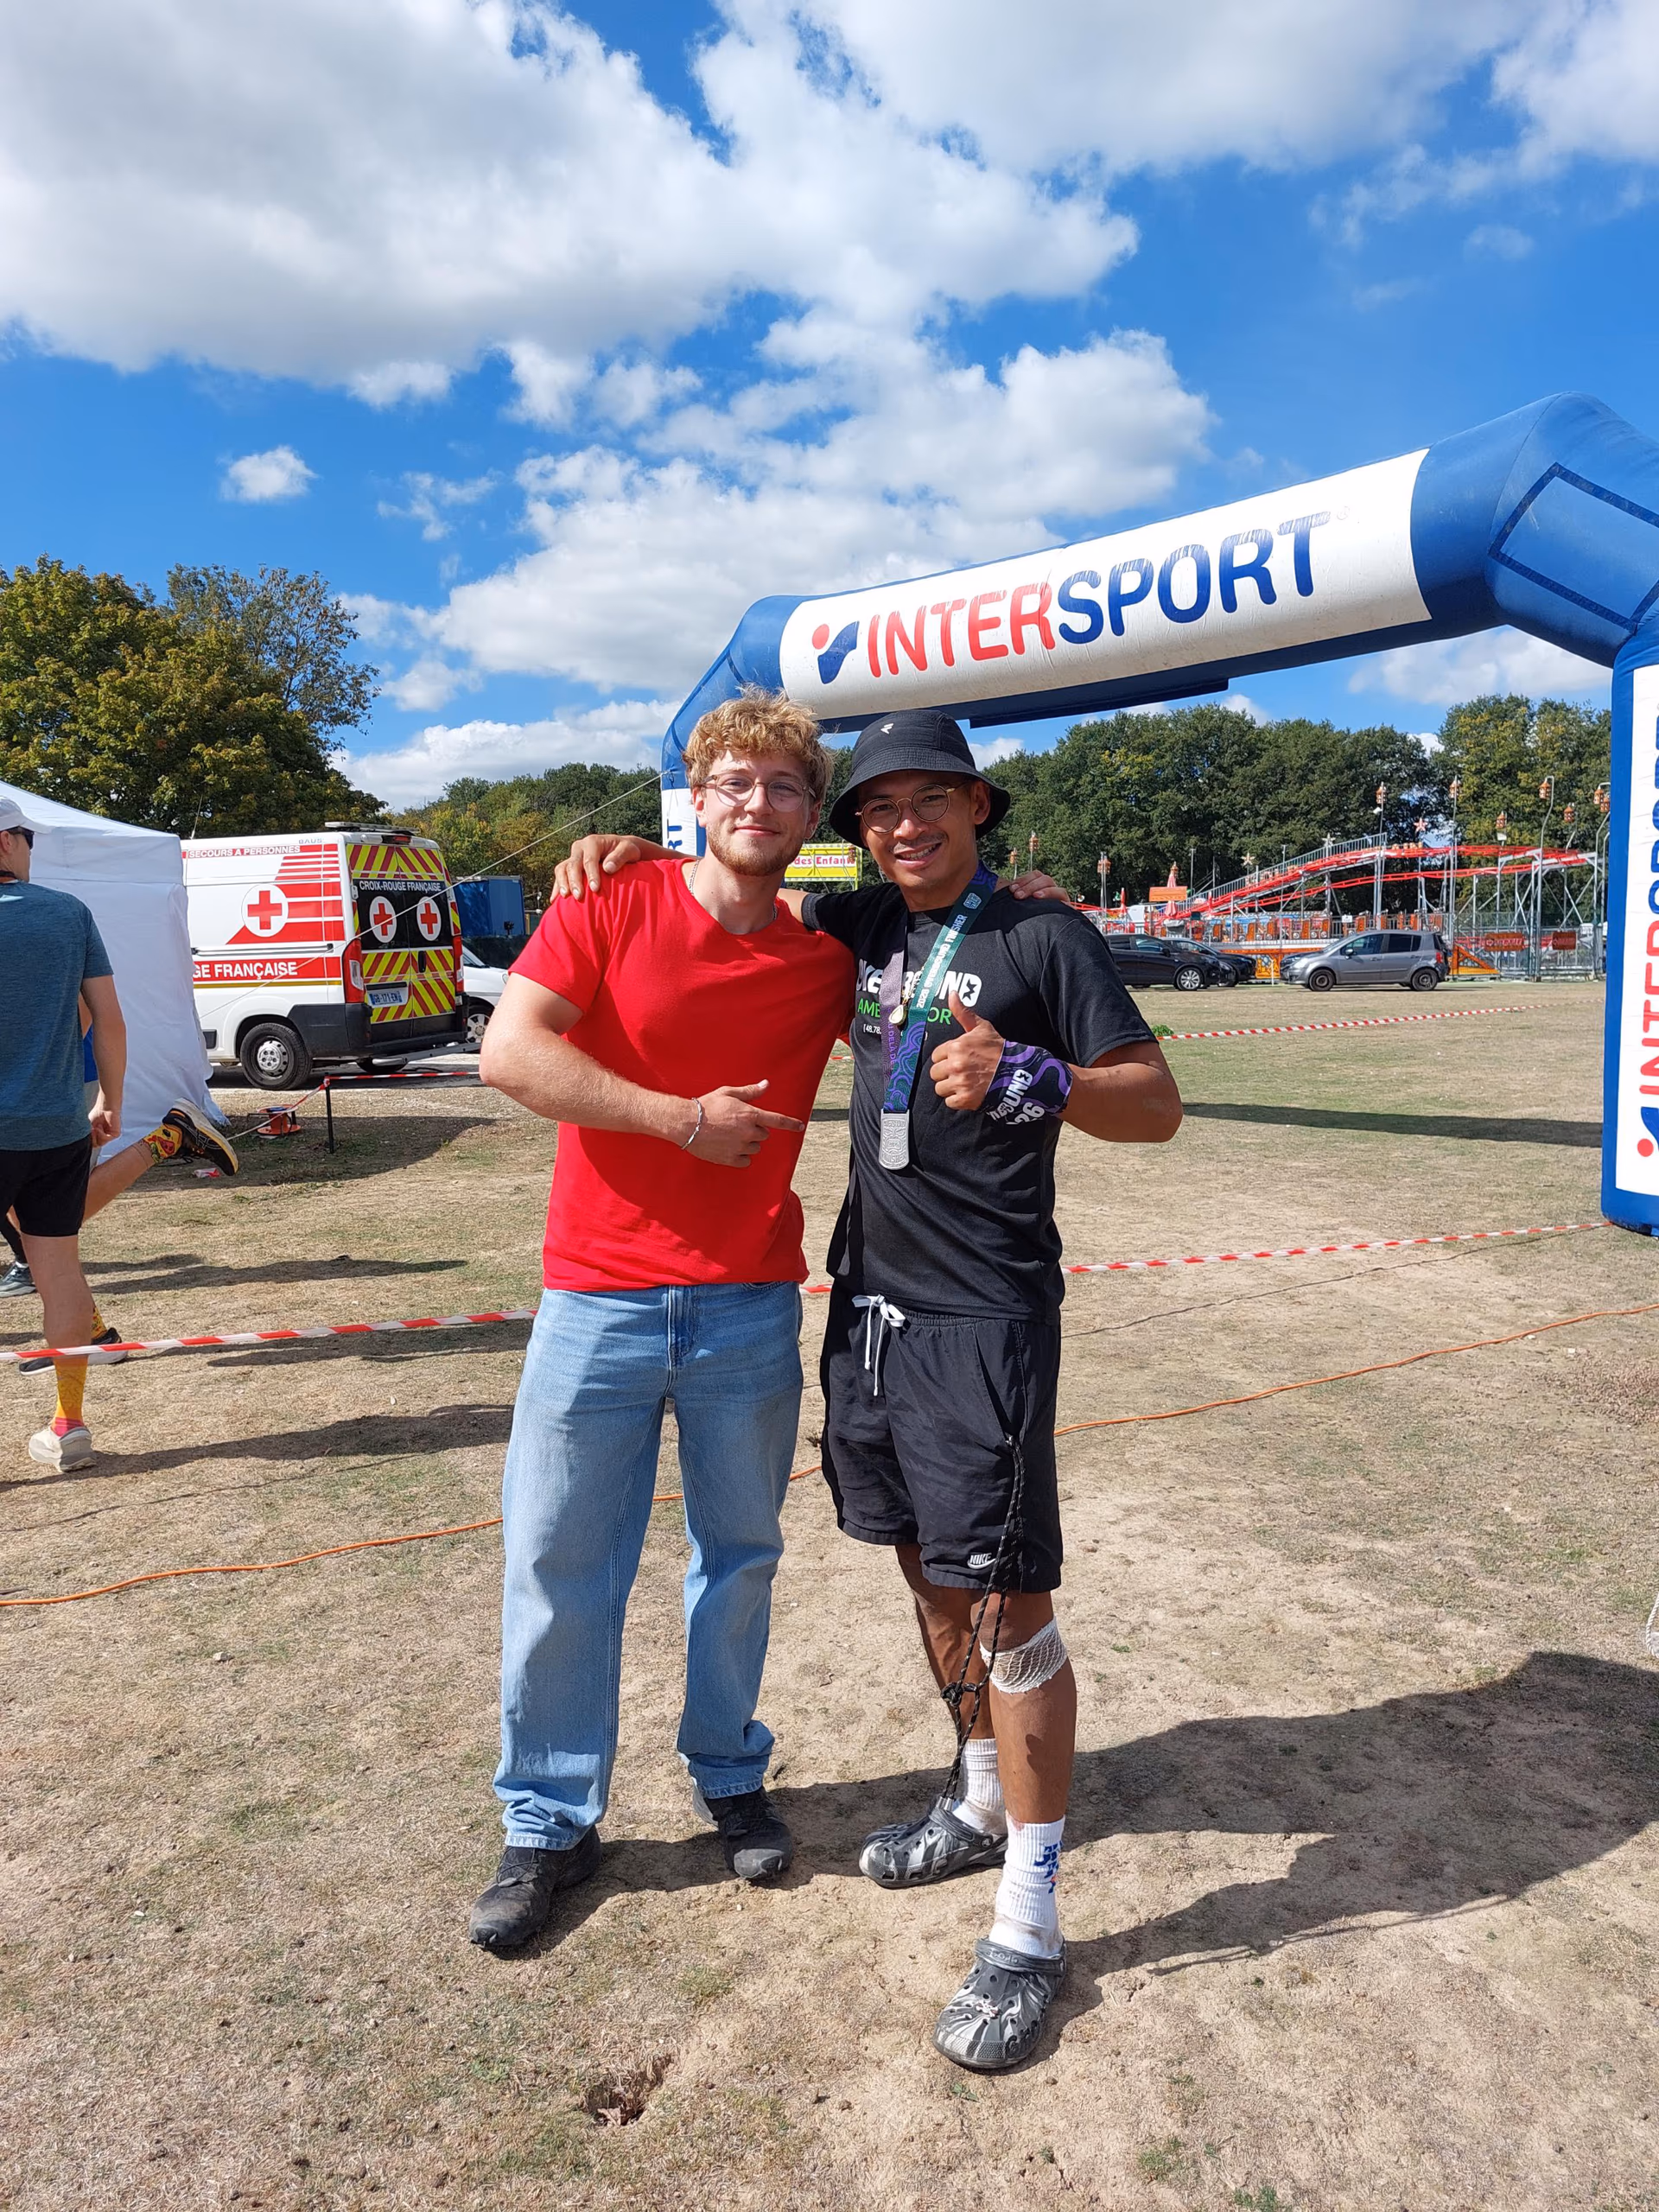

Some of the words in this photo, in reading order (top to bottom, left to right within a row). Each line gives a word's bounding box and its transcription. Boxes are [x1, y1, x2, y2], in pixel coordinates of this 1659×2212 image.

[867, 511, 1332, 678] INTERSPORT
[188, 848, 233, 858] SECOURS
[234, 848, 243, 856] A
[244, 845, 301, 855] PERSONNES
[816, 856, 855, 865] Enfan
[359, 880, 406, 891] CROIX-ROUGE
[407, 882, 442, 893] FRANÇAISE
[213, 961, 298, 980] FRANÇAISE
[969, 1552, 992, 1564] NIKE
